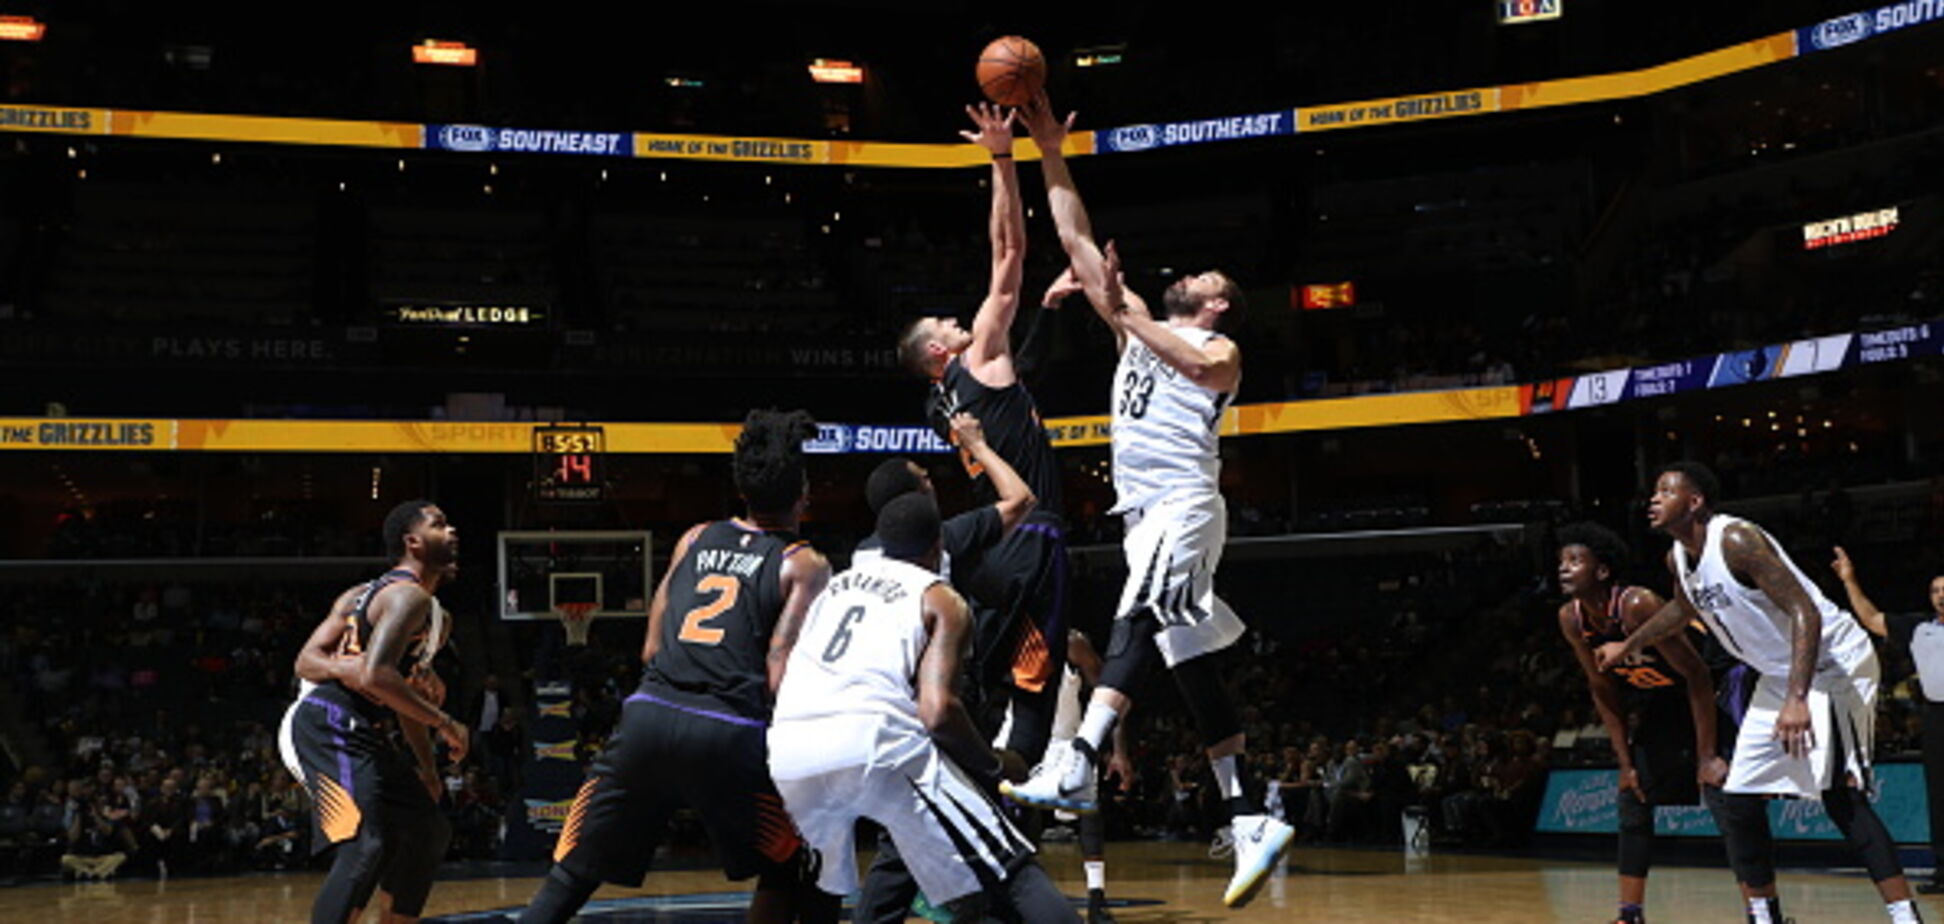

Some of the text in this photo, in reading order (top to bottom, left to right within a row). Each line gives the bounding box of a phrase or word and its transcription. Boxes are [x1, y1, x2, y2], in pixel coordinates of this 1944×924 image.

[451, 129, 620, 154] FOX SOUTHEAST
[1120, 113, 1282, 145] FOX SOUTHEAST
[464, 307, 529, 323] LEDGE
[151, 336, 243, 359] PLAYS
[789, 347, 854, 366] WINS
[1119, 370, 1155, 420] 33
[1589, 376, 1607, 401] 13
[39, 422, 154, 445] GRIZZLIES
[561, 454, 592, 482] 14
[678, 573, 740, 645] 2
[821, 605, 866, 663] 6
